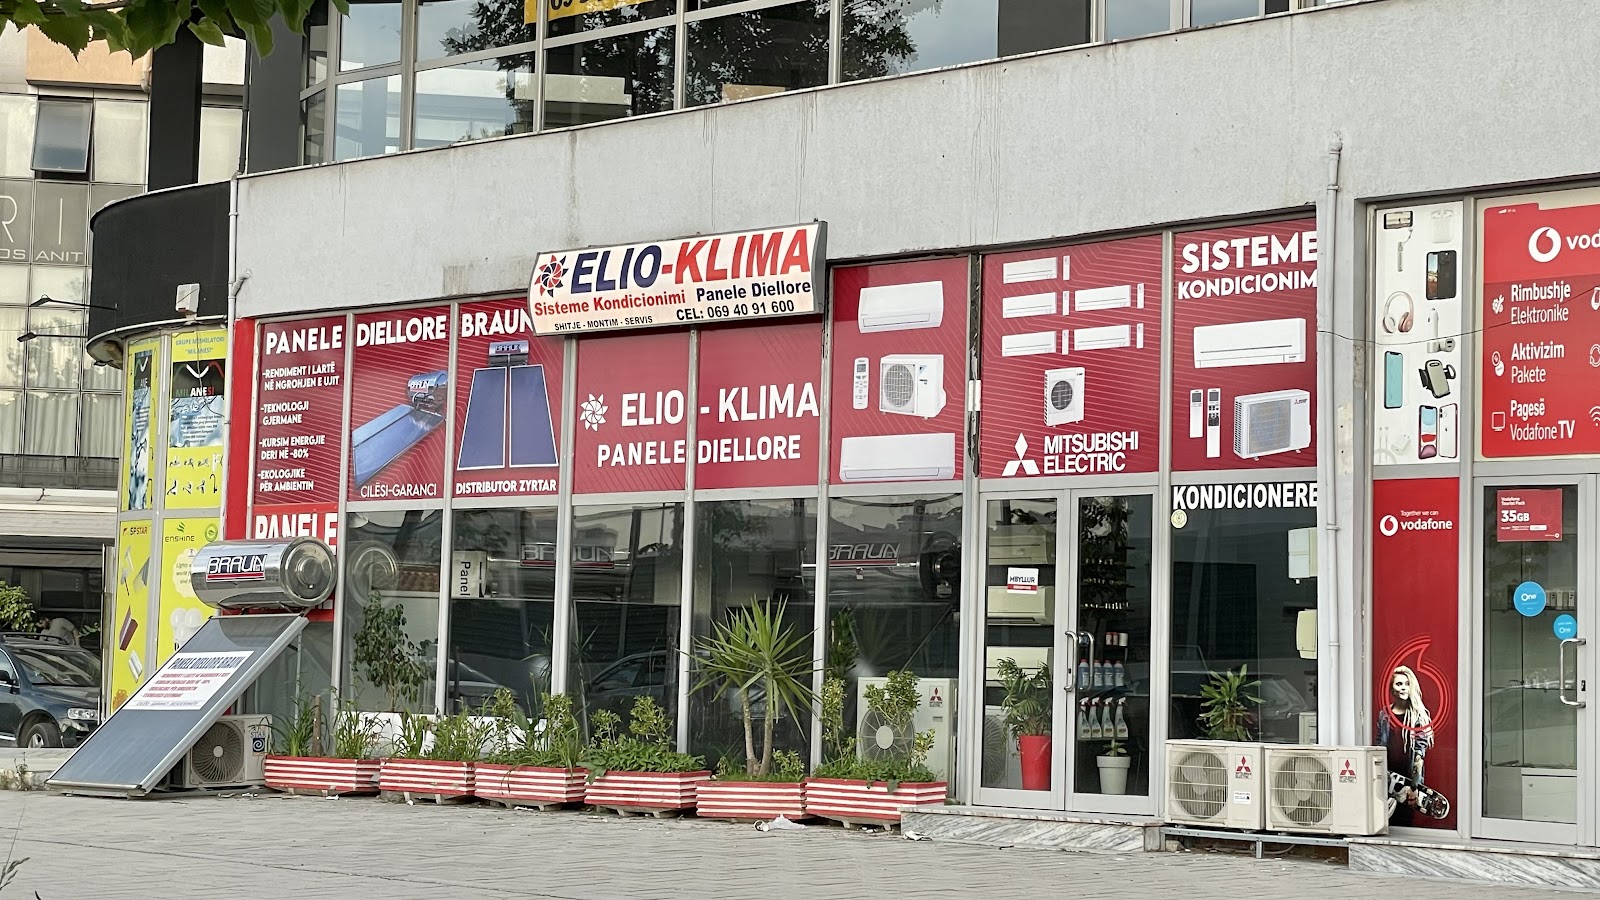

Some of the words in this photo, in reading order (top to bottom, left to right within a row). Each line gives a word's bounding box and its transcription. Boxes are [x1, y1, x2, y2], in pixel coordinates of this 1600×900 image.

[1566, 228, 1600, 250] vod
[570, 228, 811, 294] ELIO-KLIMA
[1181, 231, 1317, 274] SISTEME
[1178, 269, 1317, 300] KONDICIONIM
[1511, 280, 1571, 302] Rimbushje
[534, 301, 589, 317] Sisteme
[594, 290, 686, 311] Kondicionimi
[696, 284, 747, 303] Panele
[752, 280, 811, 297] Diellore
[676, 307, 704, 321] CEL:
[707, 305, 729, 319] 069
[733, 303, 748, 316] 40
[752, 302, 767, 315] 91
[771, 299, 795, 314] 600
[1511, 304, 1570, 325] Elektronike
[265, 325, 343, 355] PANELE
[356, 315, 447, 347] DIELLORE
[461, 308, 534, 338] BRAUN
[554, 320, 581, 331] SHITJE
[587, 318, 618, 329] MONTIM
[625, 315, 653, 326] SERVIS
[1511, 341, 1565, 361] Aktivizim
[275, 377, 316, 390] NGROHJEN
[317, 377, 322, 387] E
[324, 375, 340, 386] UJIT
[1511, 365, 1547, 384] Pakete
[621, 389, 685, 427] ELIO
[718, 382, 819, 423] KLIMA
[1510, 398, 1546, 421] Pagesë
[262, 414, 302, 425] GJERMANE
[291, 434, 326, 446] ENERGJIE
[1044, 431, 1139, 454] MITSUBISHI
[261, 449, 277, 460] DERI
[279, 447, 289, 459] NË
[290, 448, 309, 459] -80%
[597, 440, 686, 468] PANELE
[698, 435, 801, 464] DIELLORE
[1044, 452, 1126, 475] ELECTRIC
[259, 480, 273, 492] PËR
[274, 481, 314, 491] AMBIENTIN
[360, 482, 437, 498] CILËSI-GARANCI
[456, 481, 517, 495] DISTRIBUTOR
[519, 479, 557, 492] ZYRTAR
[1172, 483, 1317, 510] KONDICIONERE
[1400, 518, 1453, 530] vodafone
[207, 554, 267, 574] BRAUN
[460, 561, 470, 596] Panel
[1521, 593, 1537, 602] One
